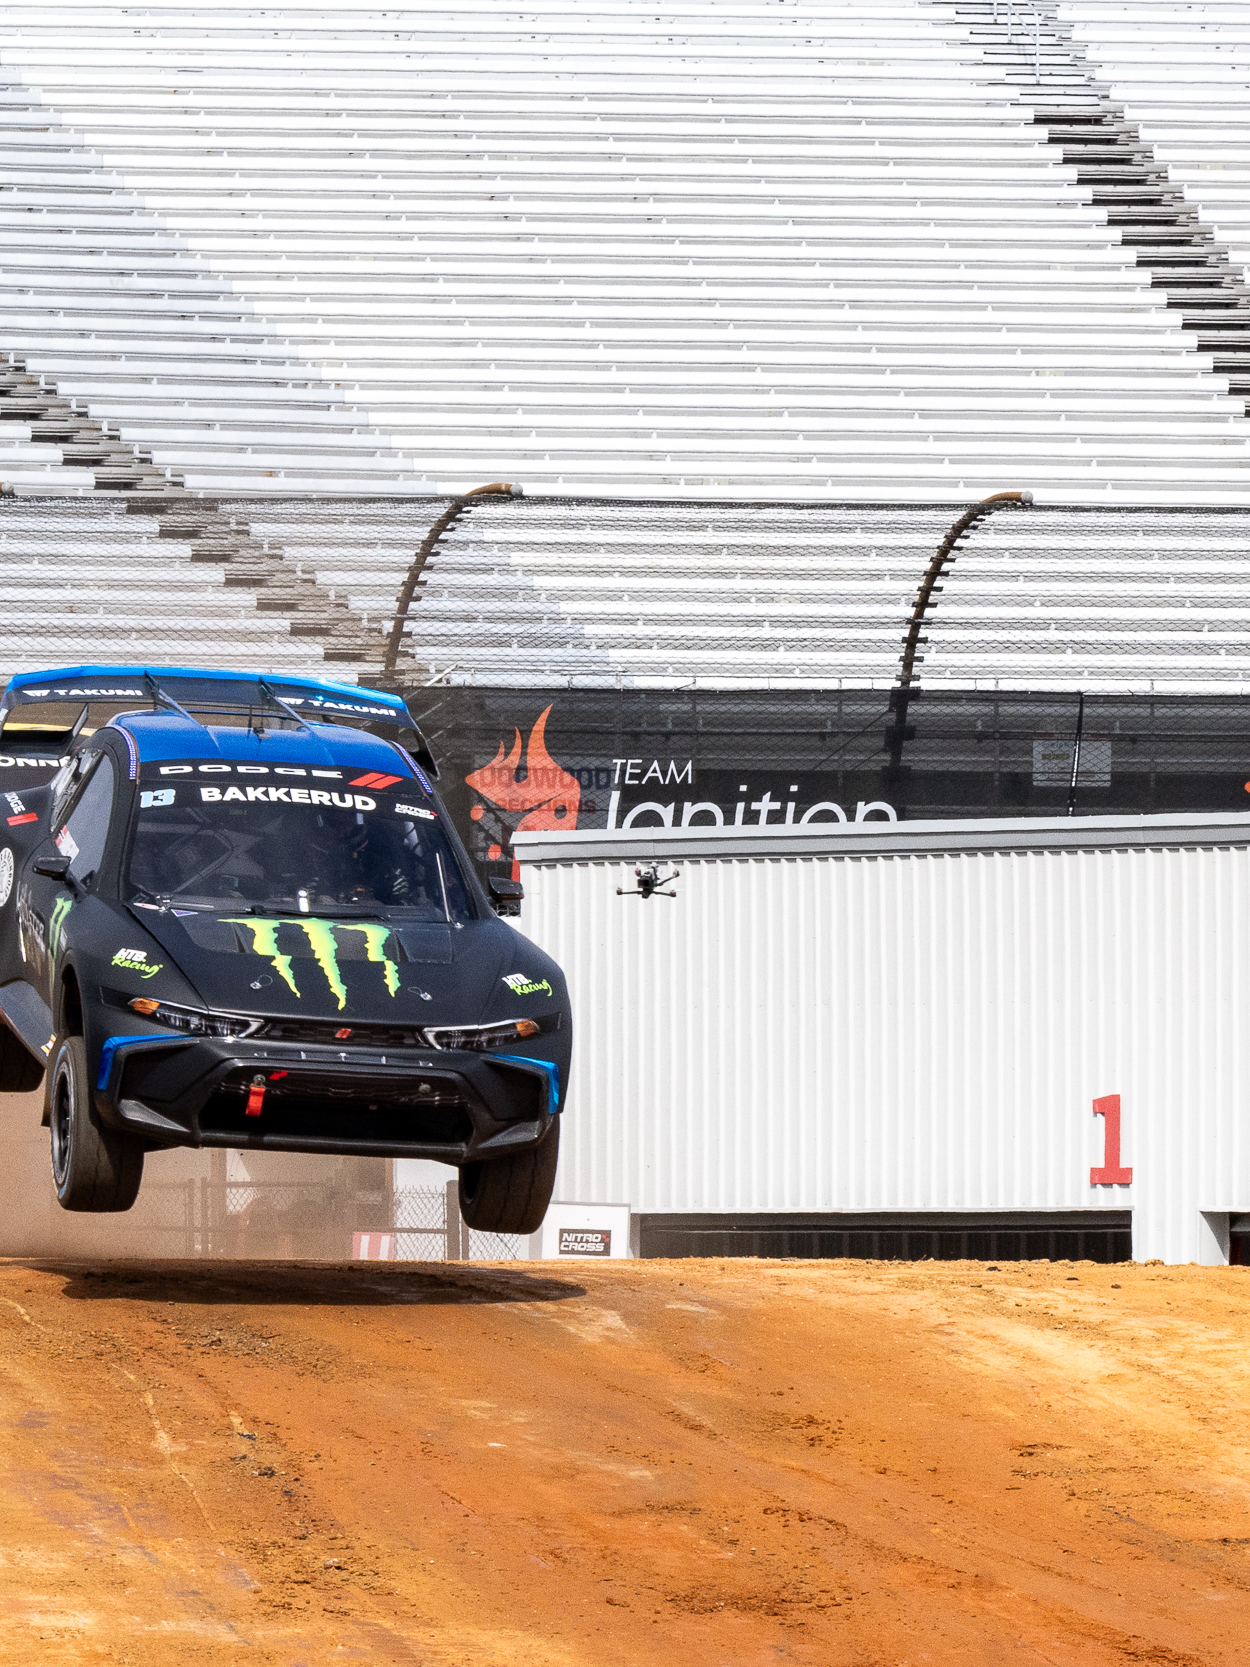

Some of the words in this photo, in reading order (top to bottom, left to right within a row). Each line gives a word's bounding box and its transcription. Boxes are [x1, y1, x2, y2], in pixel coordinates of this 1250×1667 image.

[54, 688, 143, 697] TAKUMI
[309, 700, 397, 717] TAKUMI
[159, 764, 344, 779] DODGE
[613, 758, 693, 785] TEAM
[140, 789, 176, 809] 13
[200, 787, 377, 811] BAKKERUD
[1090, 1094, 1133, 1185] 1
[562, 1232, 602, 1243] NITRO
[560, 1242, 605, 1252] CROSS
